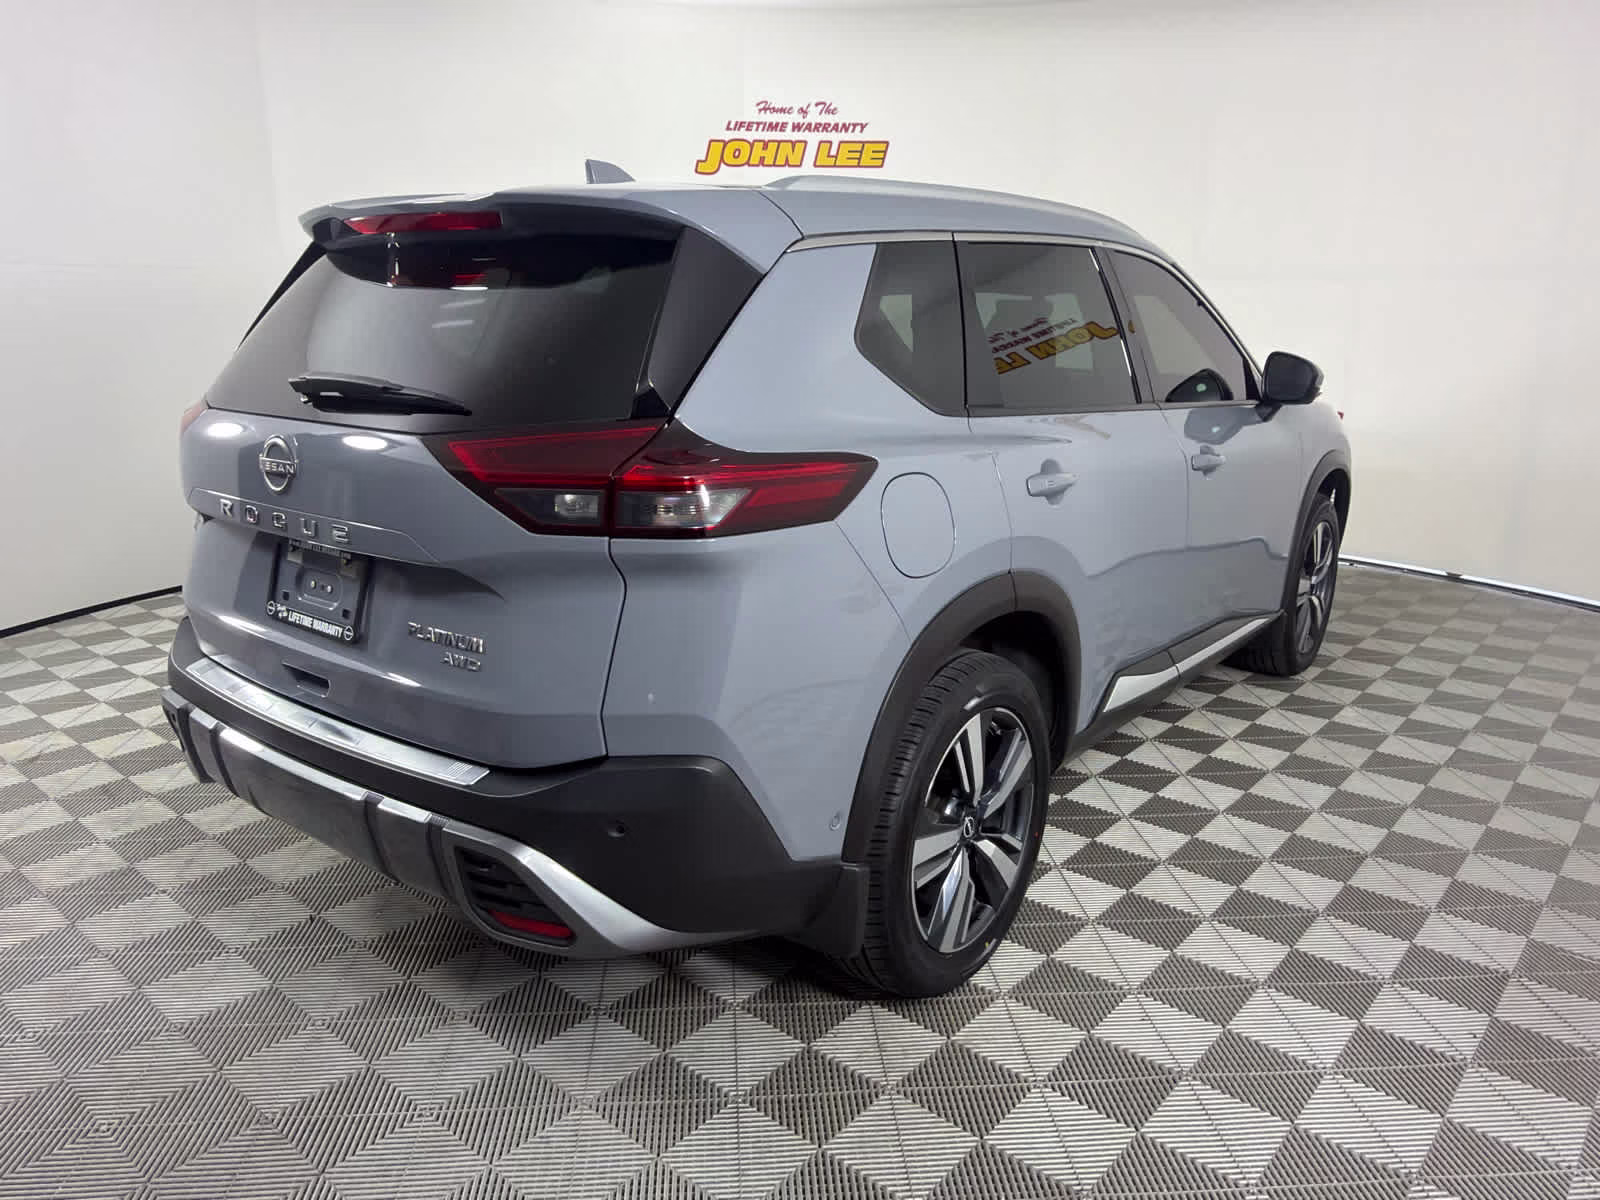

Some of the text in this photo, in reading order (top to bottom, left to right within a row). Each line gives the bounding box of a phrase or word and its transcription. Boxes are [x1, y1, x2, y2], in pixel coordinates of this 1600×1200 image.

[755, 100, 838, 119] Home of The
[725, 120, 869, 134] LIFETIME WARRANTY
[695, 138, 889, 175] JOHN LEE
[219, 498, 350, 544] ROGUE
[407, 620, 484, 654] PLATINUM
[443, 651, 481, 672] AWD
